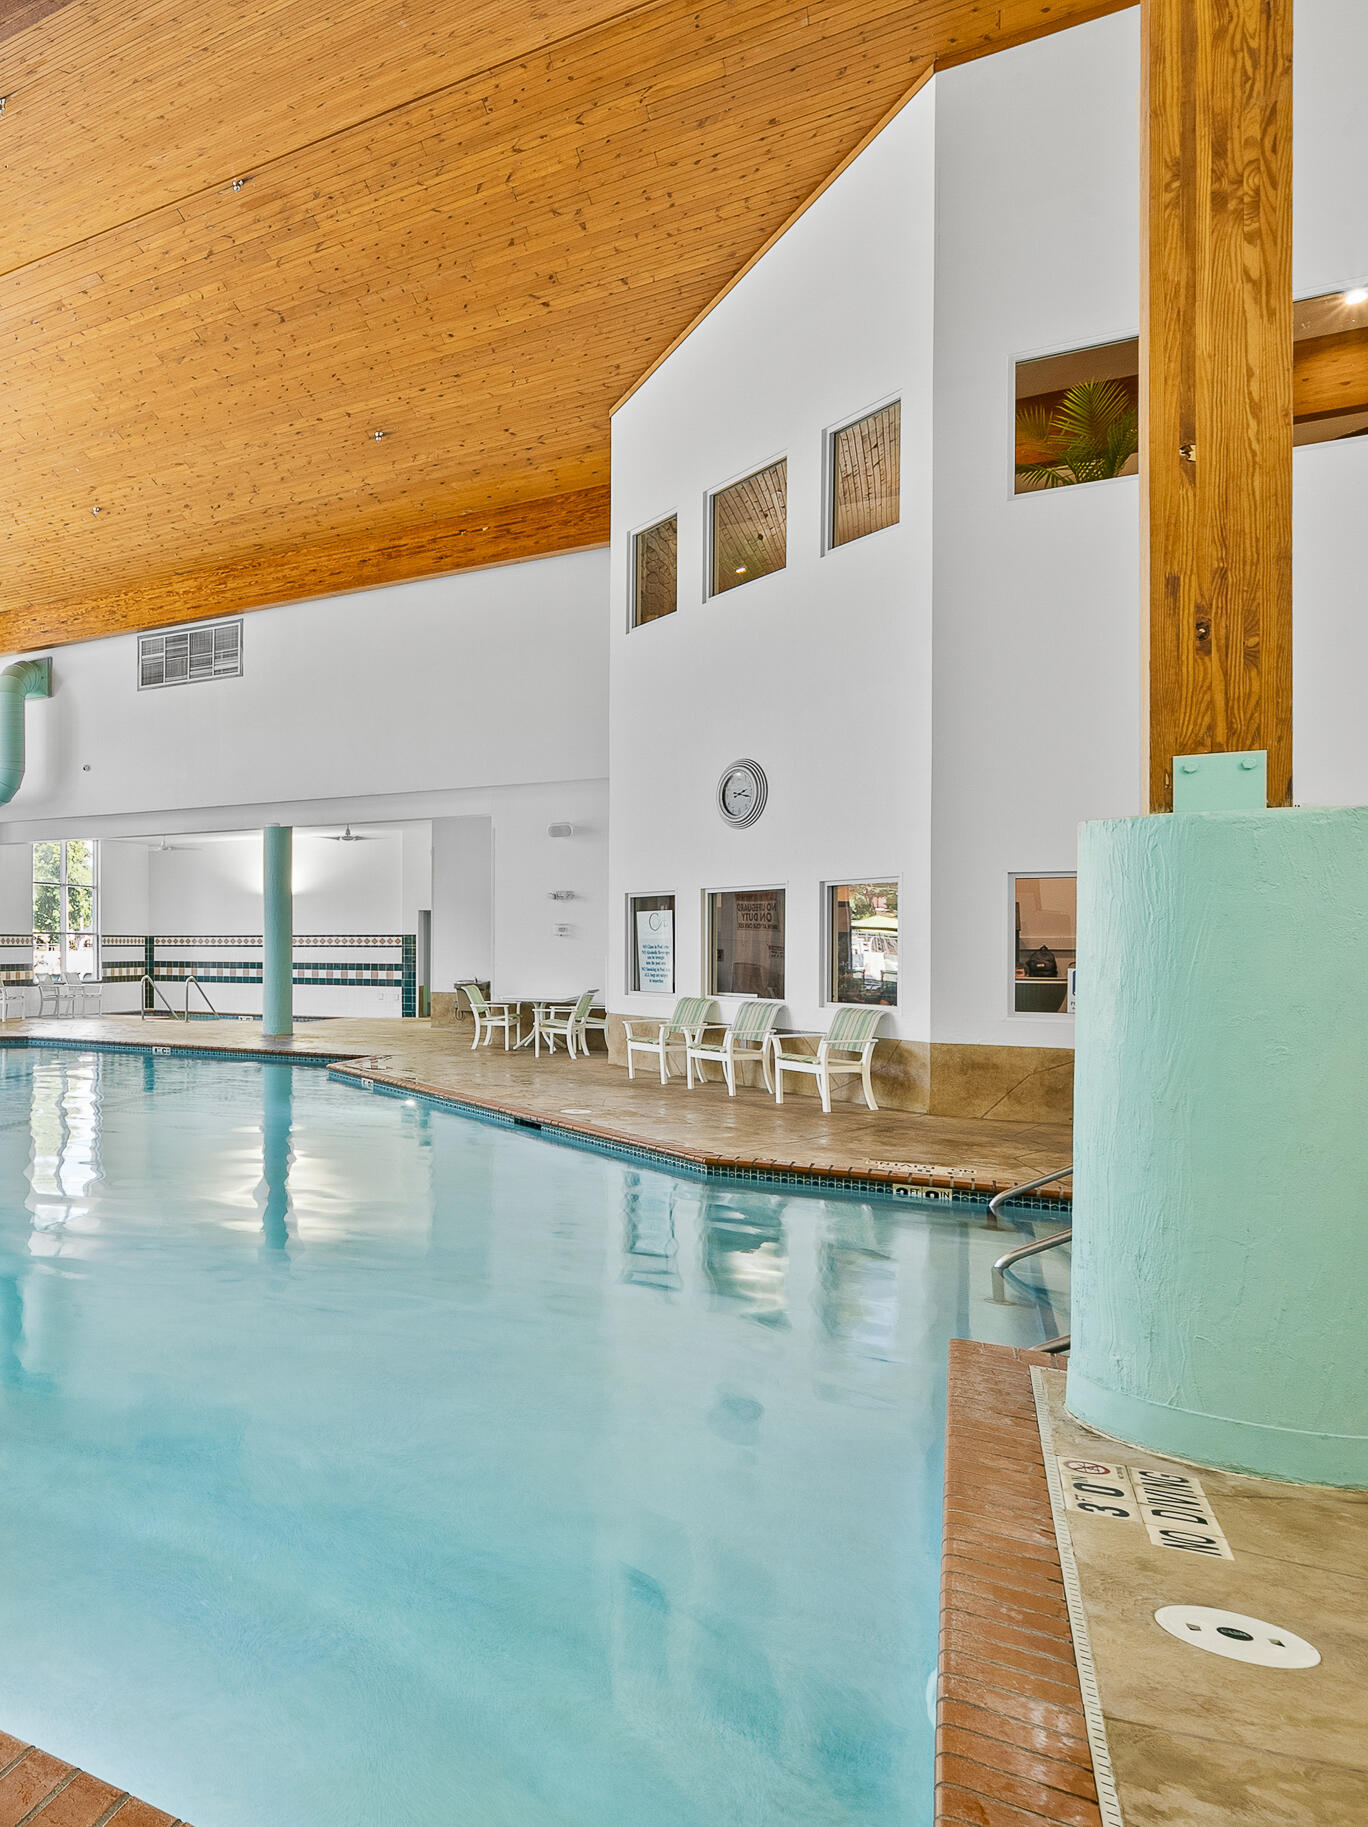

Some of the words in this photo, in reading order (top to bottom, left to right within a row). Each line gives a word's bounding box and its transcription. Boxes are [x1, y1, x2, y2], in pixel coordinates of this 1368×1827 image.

[1073, 1482, 1125, 1497] 0
[1138, 1470, 1209, 1526] DIVING
[1077, 1502, 1130, 1518] 3
[1159, 1529, 1222, 1557] NO
